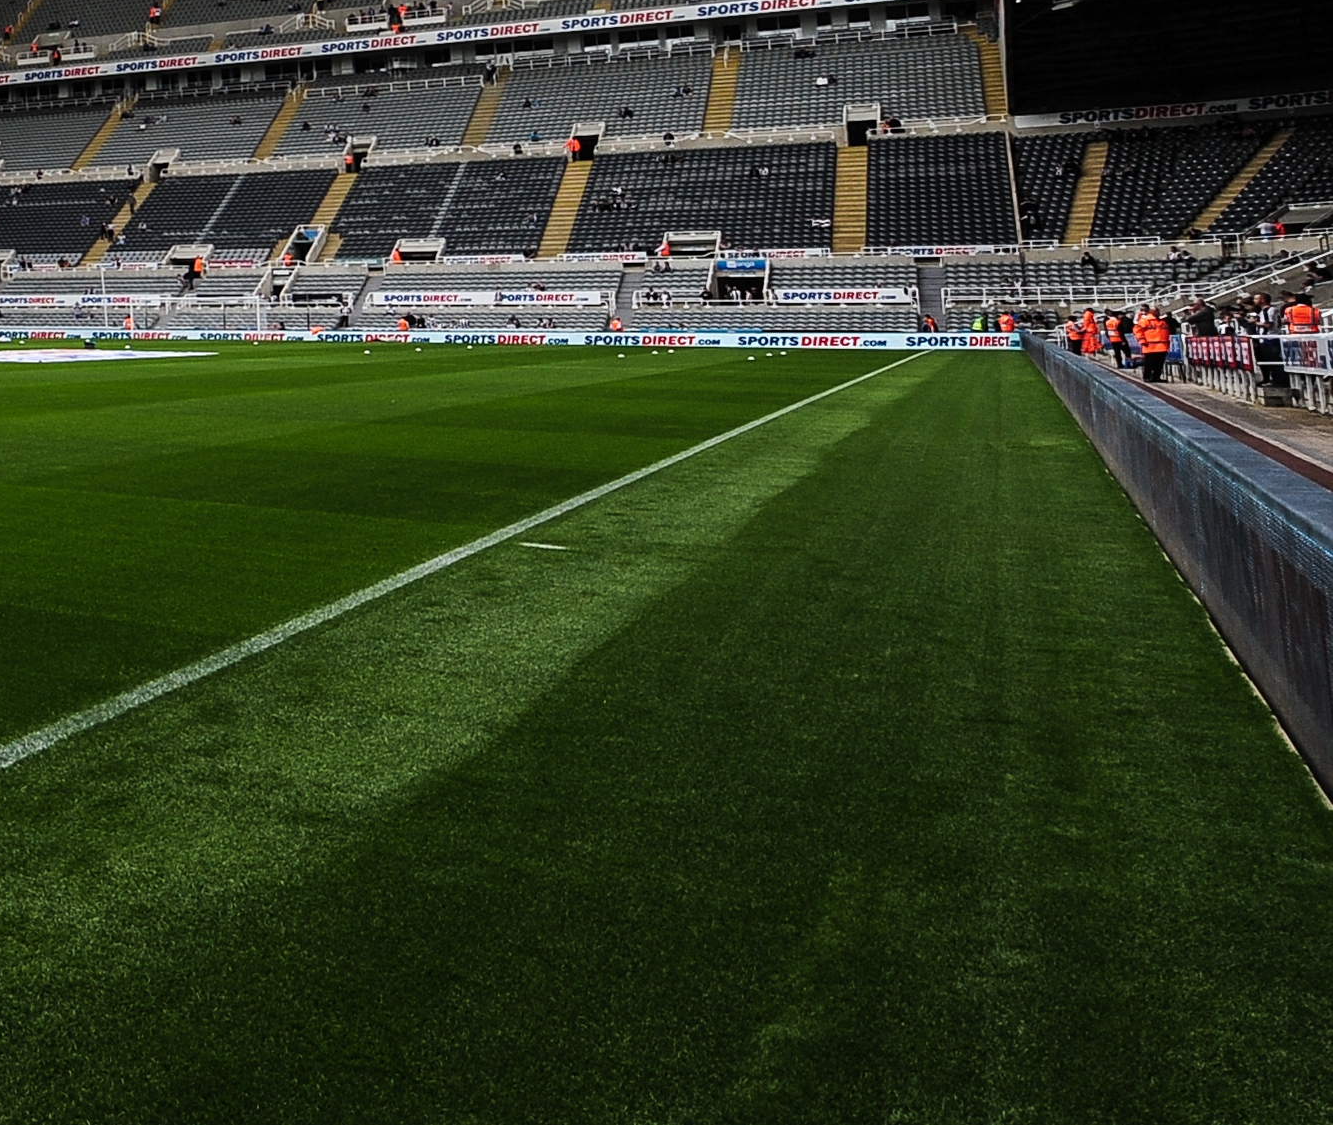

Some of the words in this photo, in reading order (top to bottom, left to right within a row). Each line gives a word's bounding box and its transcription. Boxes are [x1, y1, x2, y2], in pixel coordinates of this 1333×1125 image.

[1248, 91, 1333, 110] SPORTS
[501, 293, 589, 302] PORTSDIRECT.COM
[444, 334, 569, 345] SPORTSDIRECT.COM
[584, 335, 721, 346] SPORTSDIRECT.COM
[738, 336, 887, 347] SPORTSDIRECT.COM
